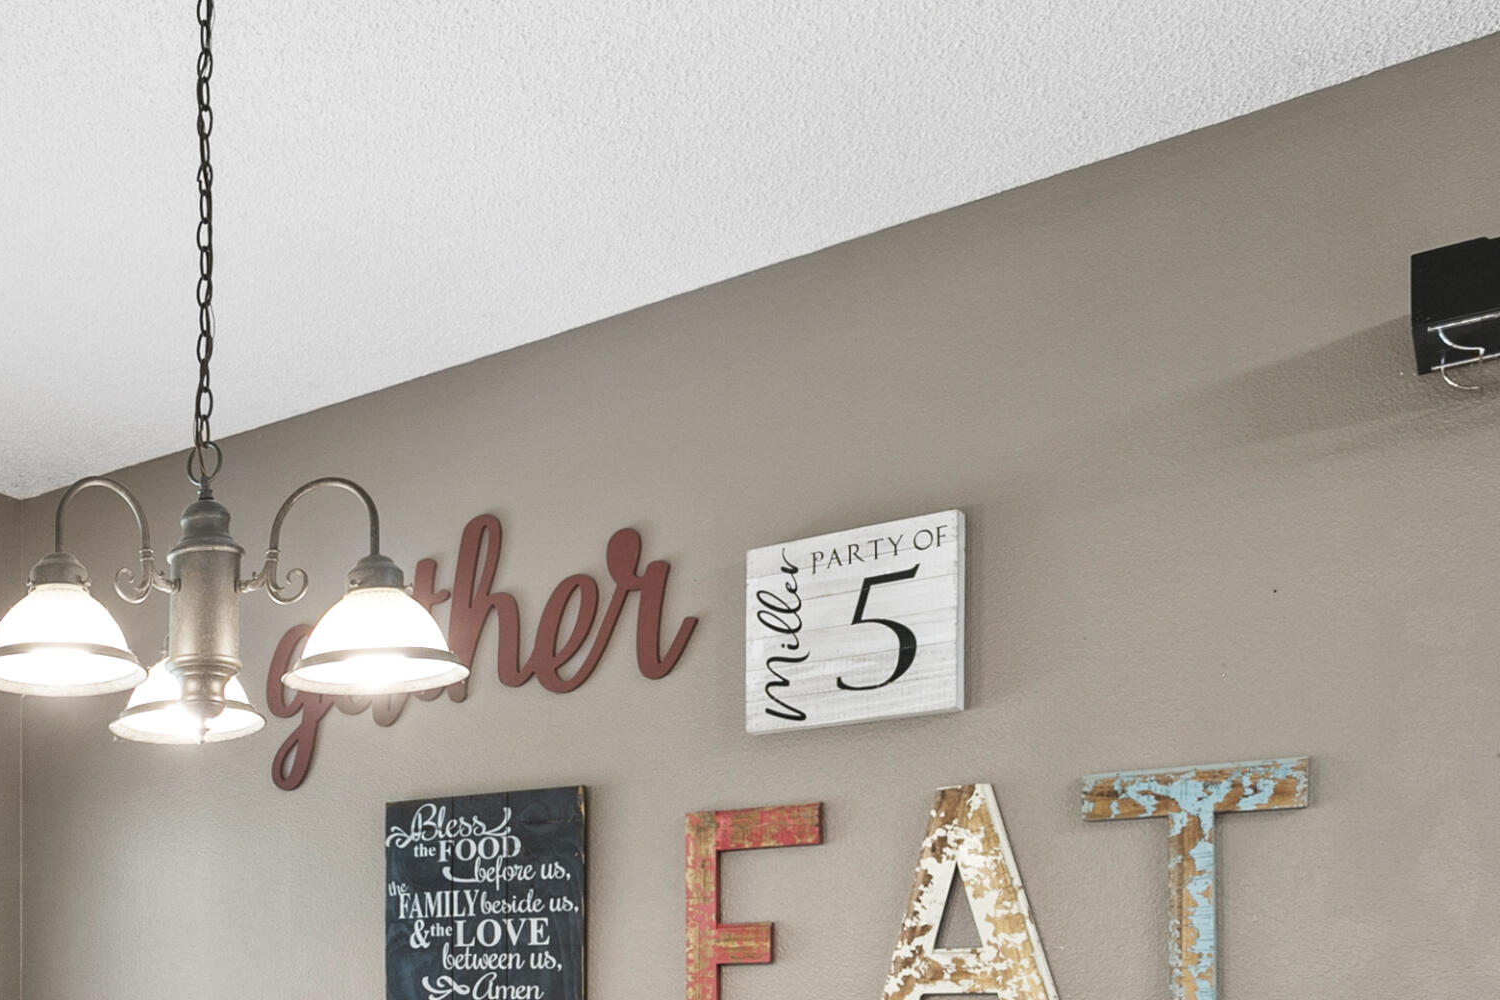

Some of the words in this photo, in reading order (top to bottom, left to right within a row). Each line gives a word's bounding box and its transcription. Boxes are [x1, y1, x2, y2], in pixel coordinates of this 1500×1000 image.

[810, 534, 904, 575] PARTY
[913, 525, 949, 551] OF
[836, 563, 920, 691] 5
[386, 803, 512, 849] Bless
[413, 844, 437, 858] the
[438, 835, 522, 862] FOOD
[442, 855, 536, 891] before
[540, 861, 571, 881] us,
[388, 881, 409, 896] the
[479, 889, 545, 915] beside
[398, 889, 479, 919] FAMILY
[549, 896, 579, 913] us,
[409, 919, 431, 949] &
[430, 923, 453, 937] the
[454, 917, 551, 947] LOVE
[442, 942, 525, 970] between
[529, 950, 563, 971] us,
[472, 972, 545, 1000] Amen
